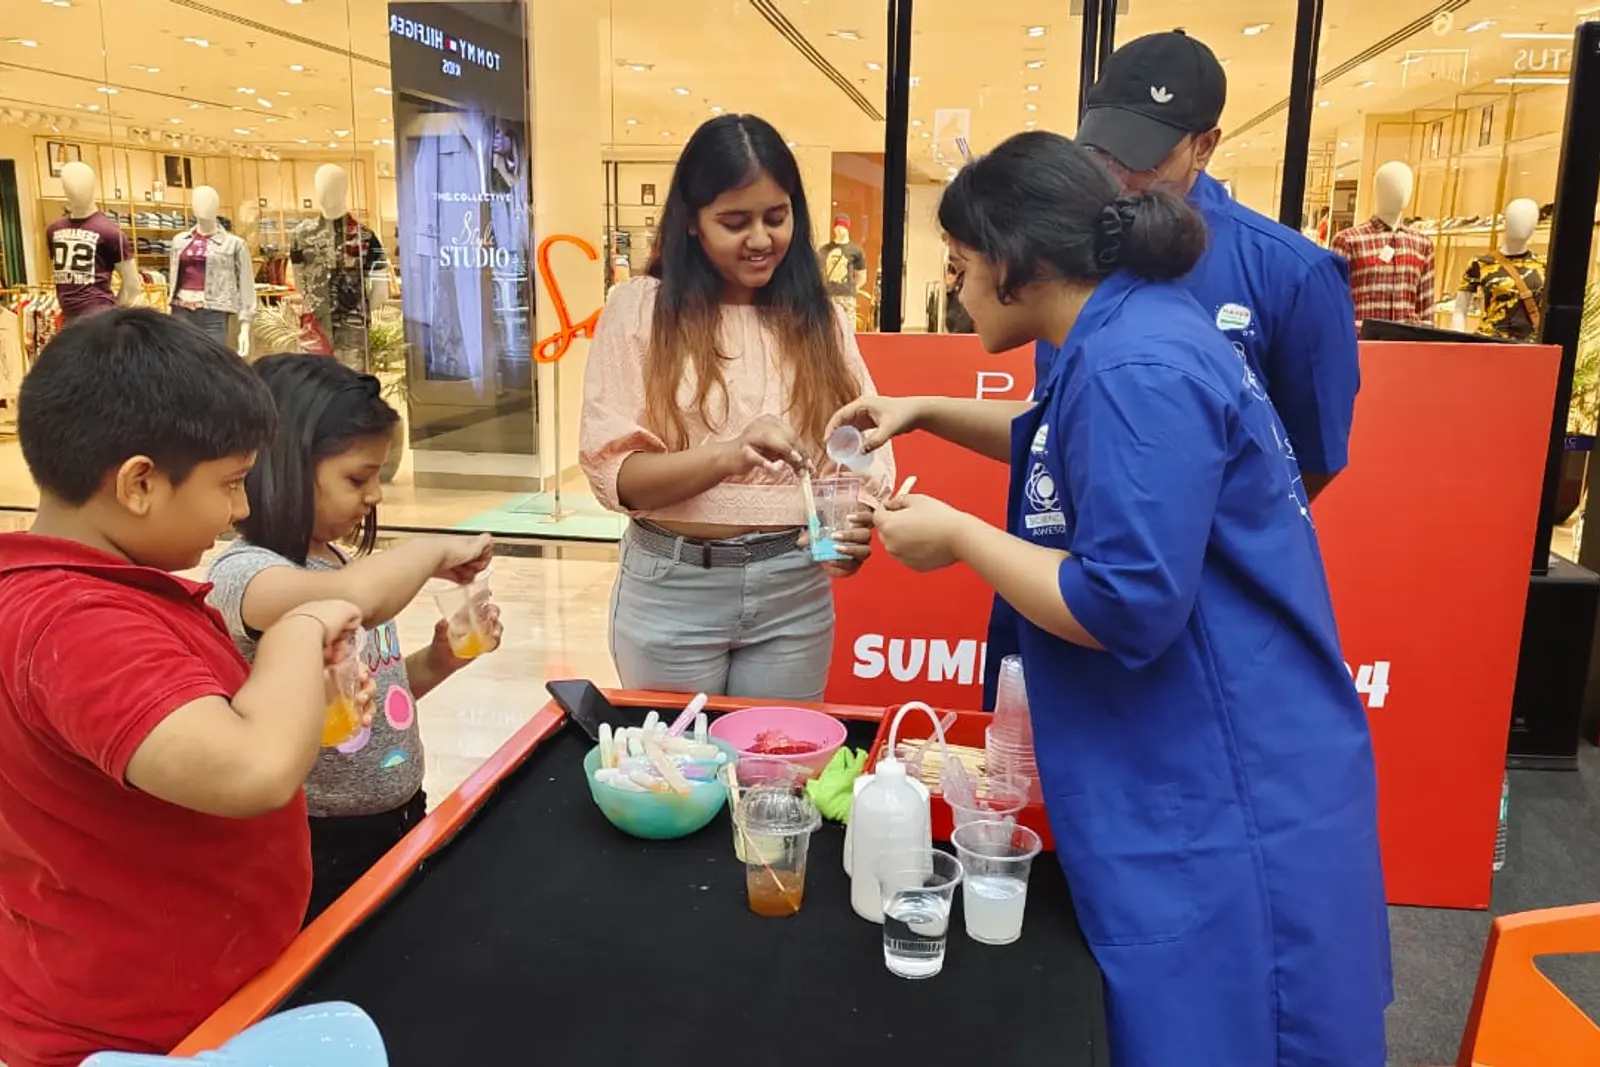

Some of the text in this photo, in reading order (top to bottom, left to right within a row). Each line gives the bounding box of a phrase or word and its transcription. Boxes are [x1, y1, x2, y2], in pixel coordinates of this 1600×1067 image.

[454, 192, 512, 201] COLLECTIVE
[53, 241, 94, 271] 02
[440, 245, 509, 268] STUDIO
[976, 371, 1035, 401] P
[853, 633, 987, 685] SUM
